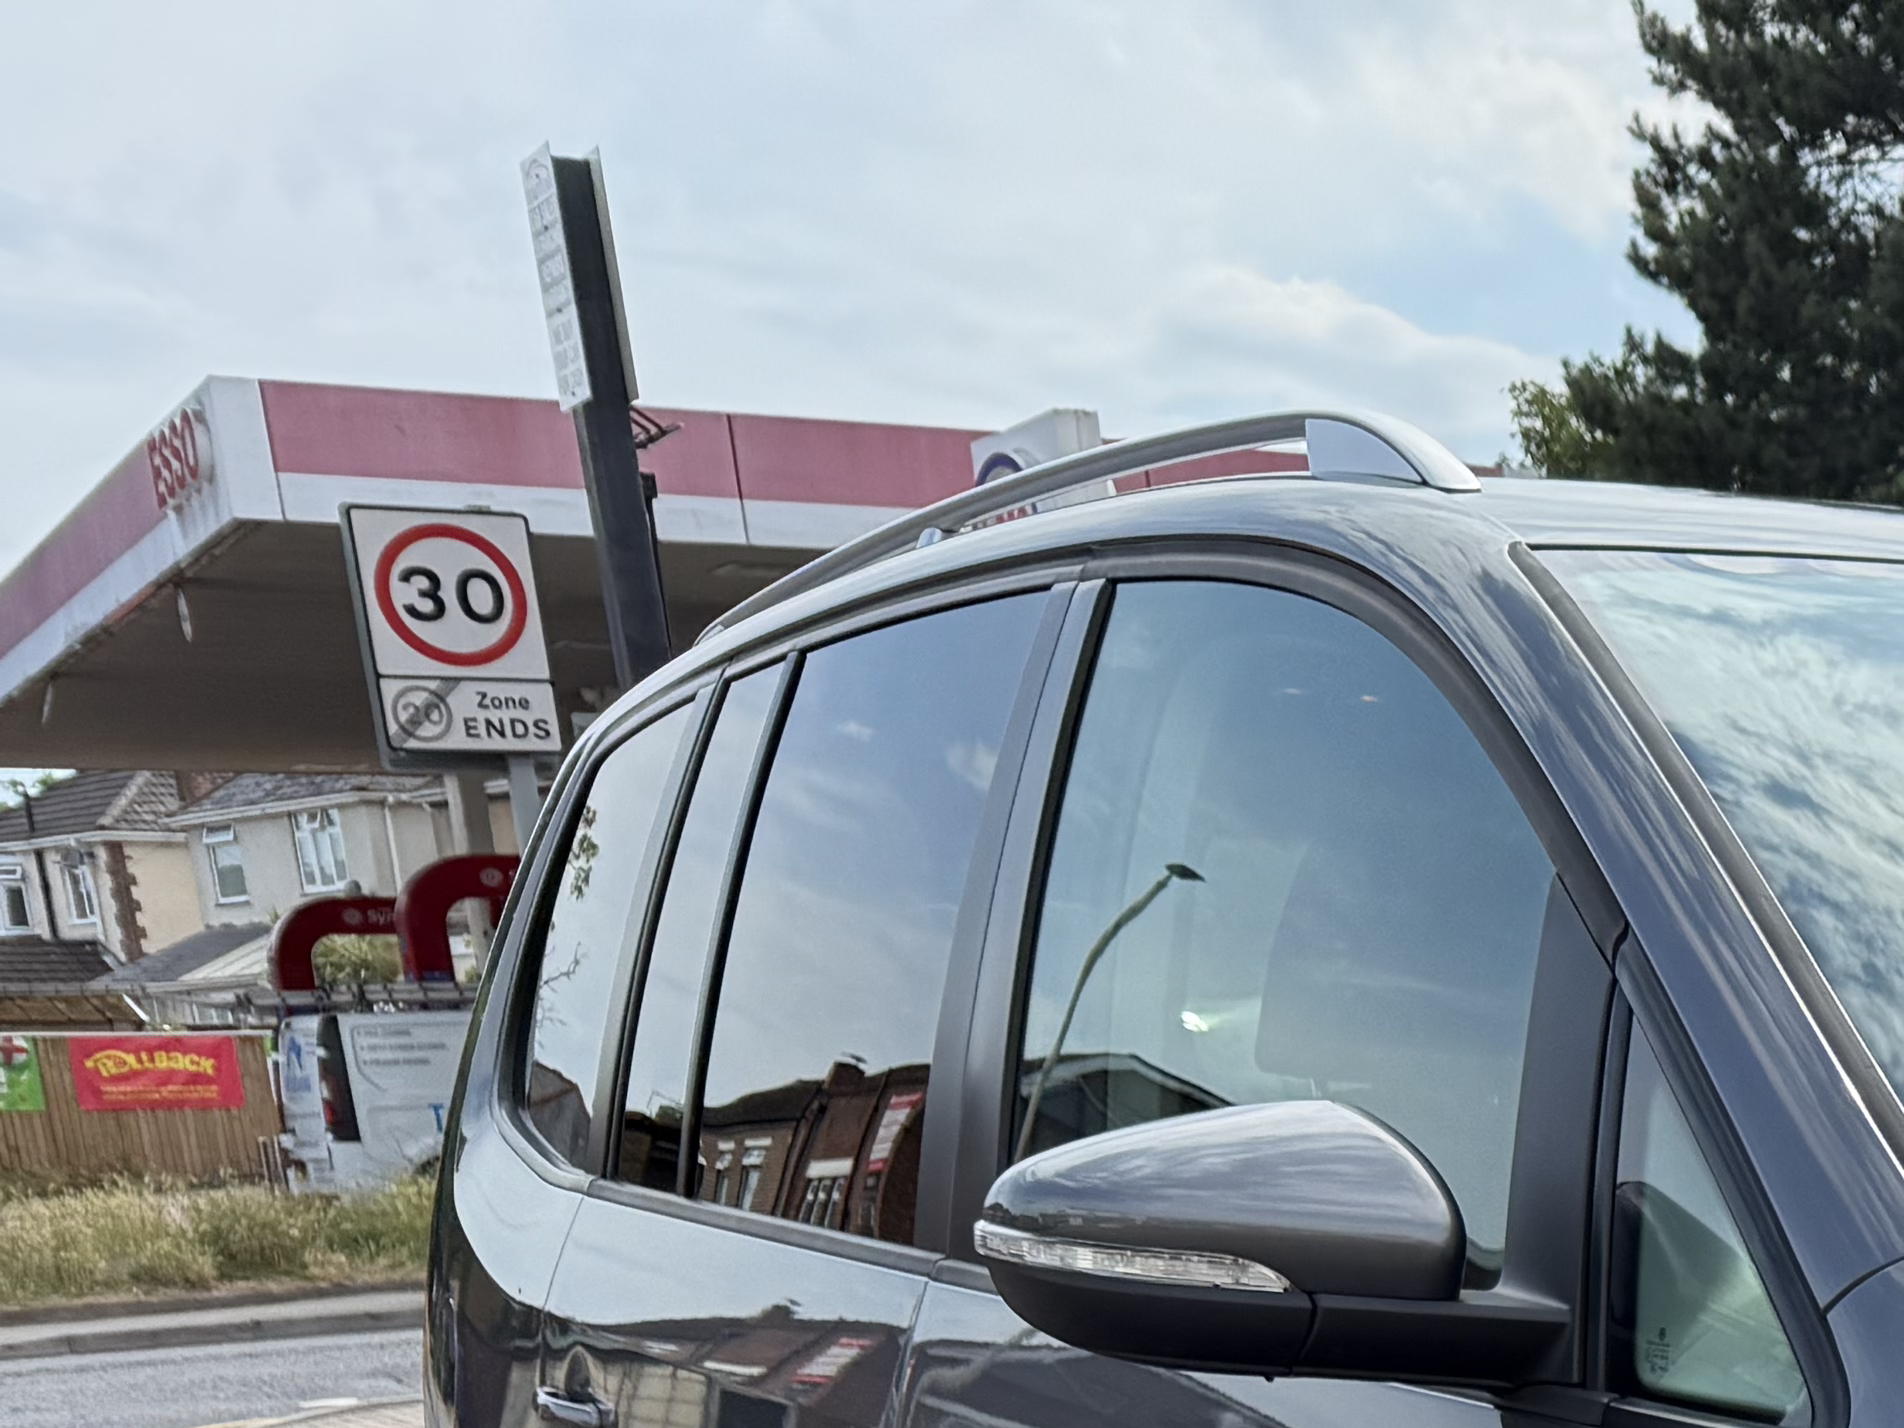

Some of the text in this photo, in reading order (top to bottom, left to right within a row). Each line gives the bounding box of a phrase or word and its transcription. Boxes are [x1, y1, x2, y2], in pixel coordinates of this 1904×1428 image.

[397, 565, 505, 624] 30
[475, 691, 530, 710] Zone
[401, 702, 444, 726] 20
[463, 716, 552, 740] ENDS
